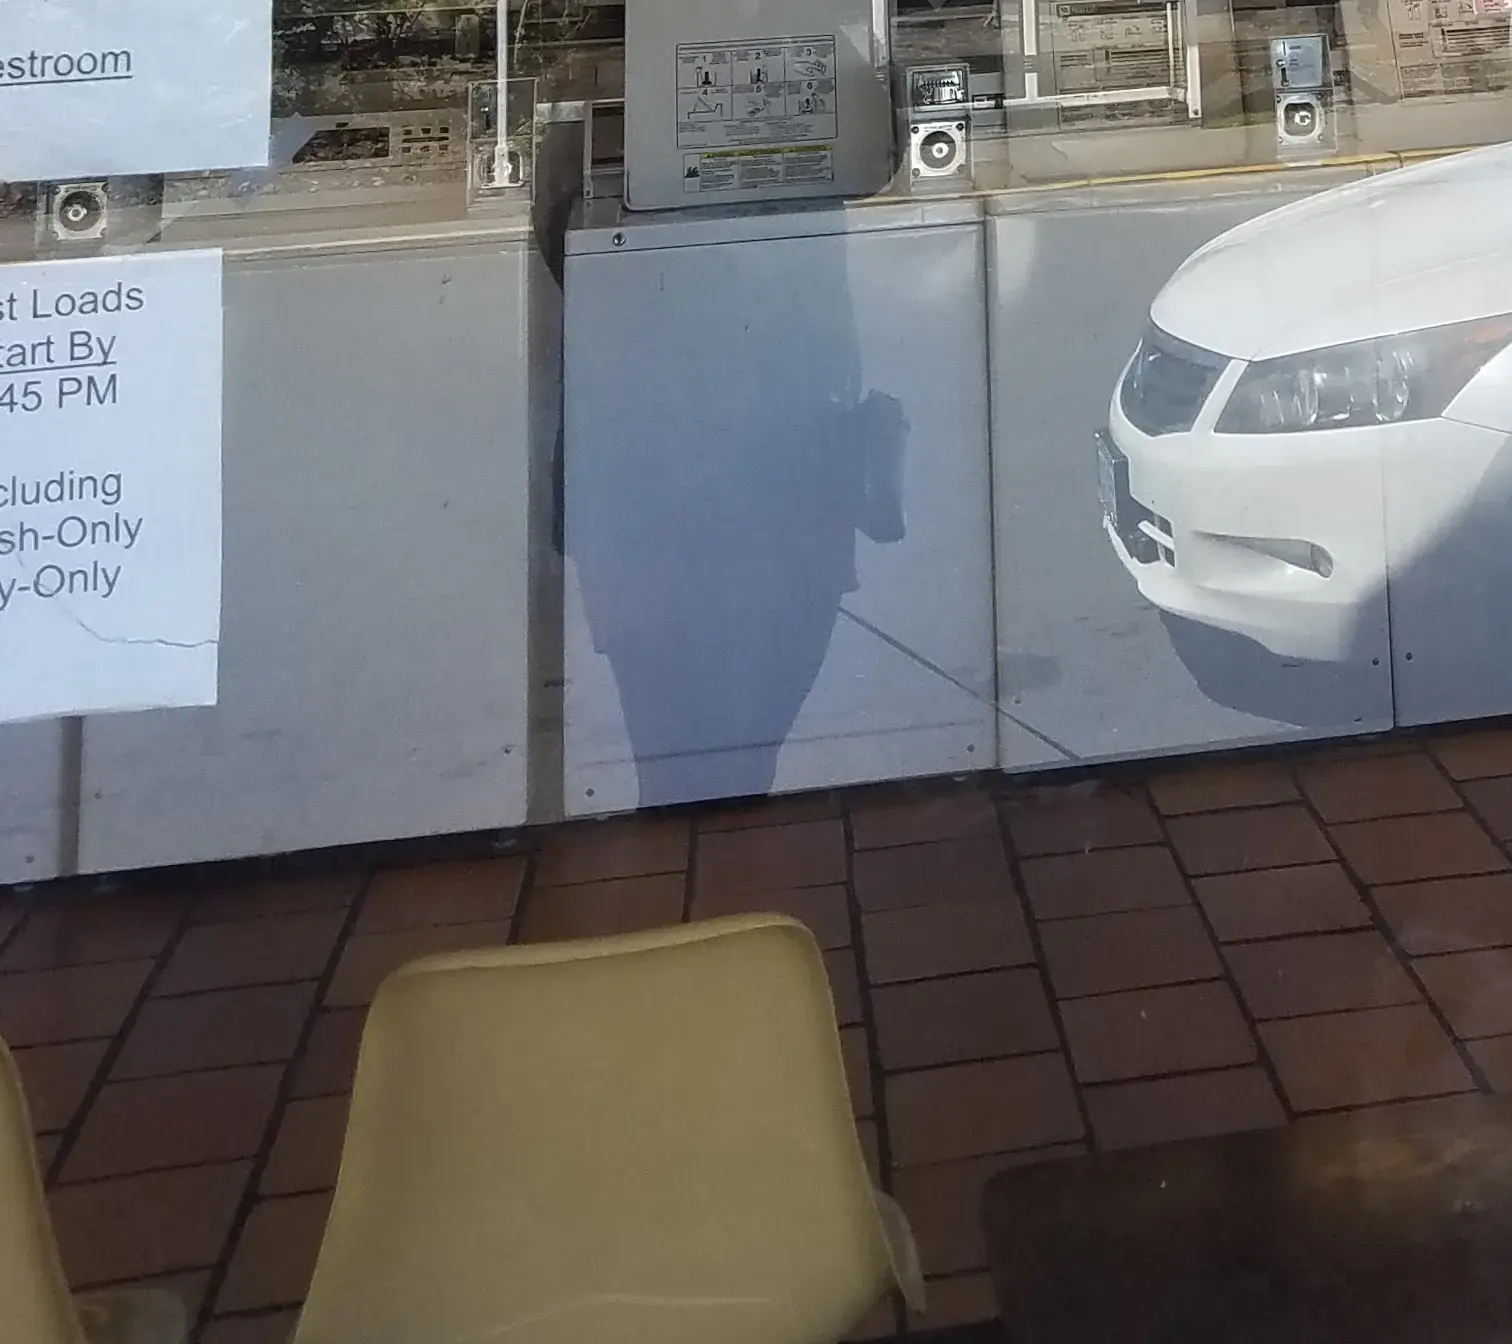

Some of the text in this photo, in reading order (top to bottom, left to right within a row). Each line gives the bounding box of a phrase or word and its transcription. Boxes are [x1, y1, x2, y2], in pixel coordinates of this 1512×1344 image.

[0, 281, 144, 321] t Loads
[0, 330, 117, 368] art By
[58, 373, 118, 408] PM
